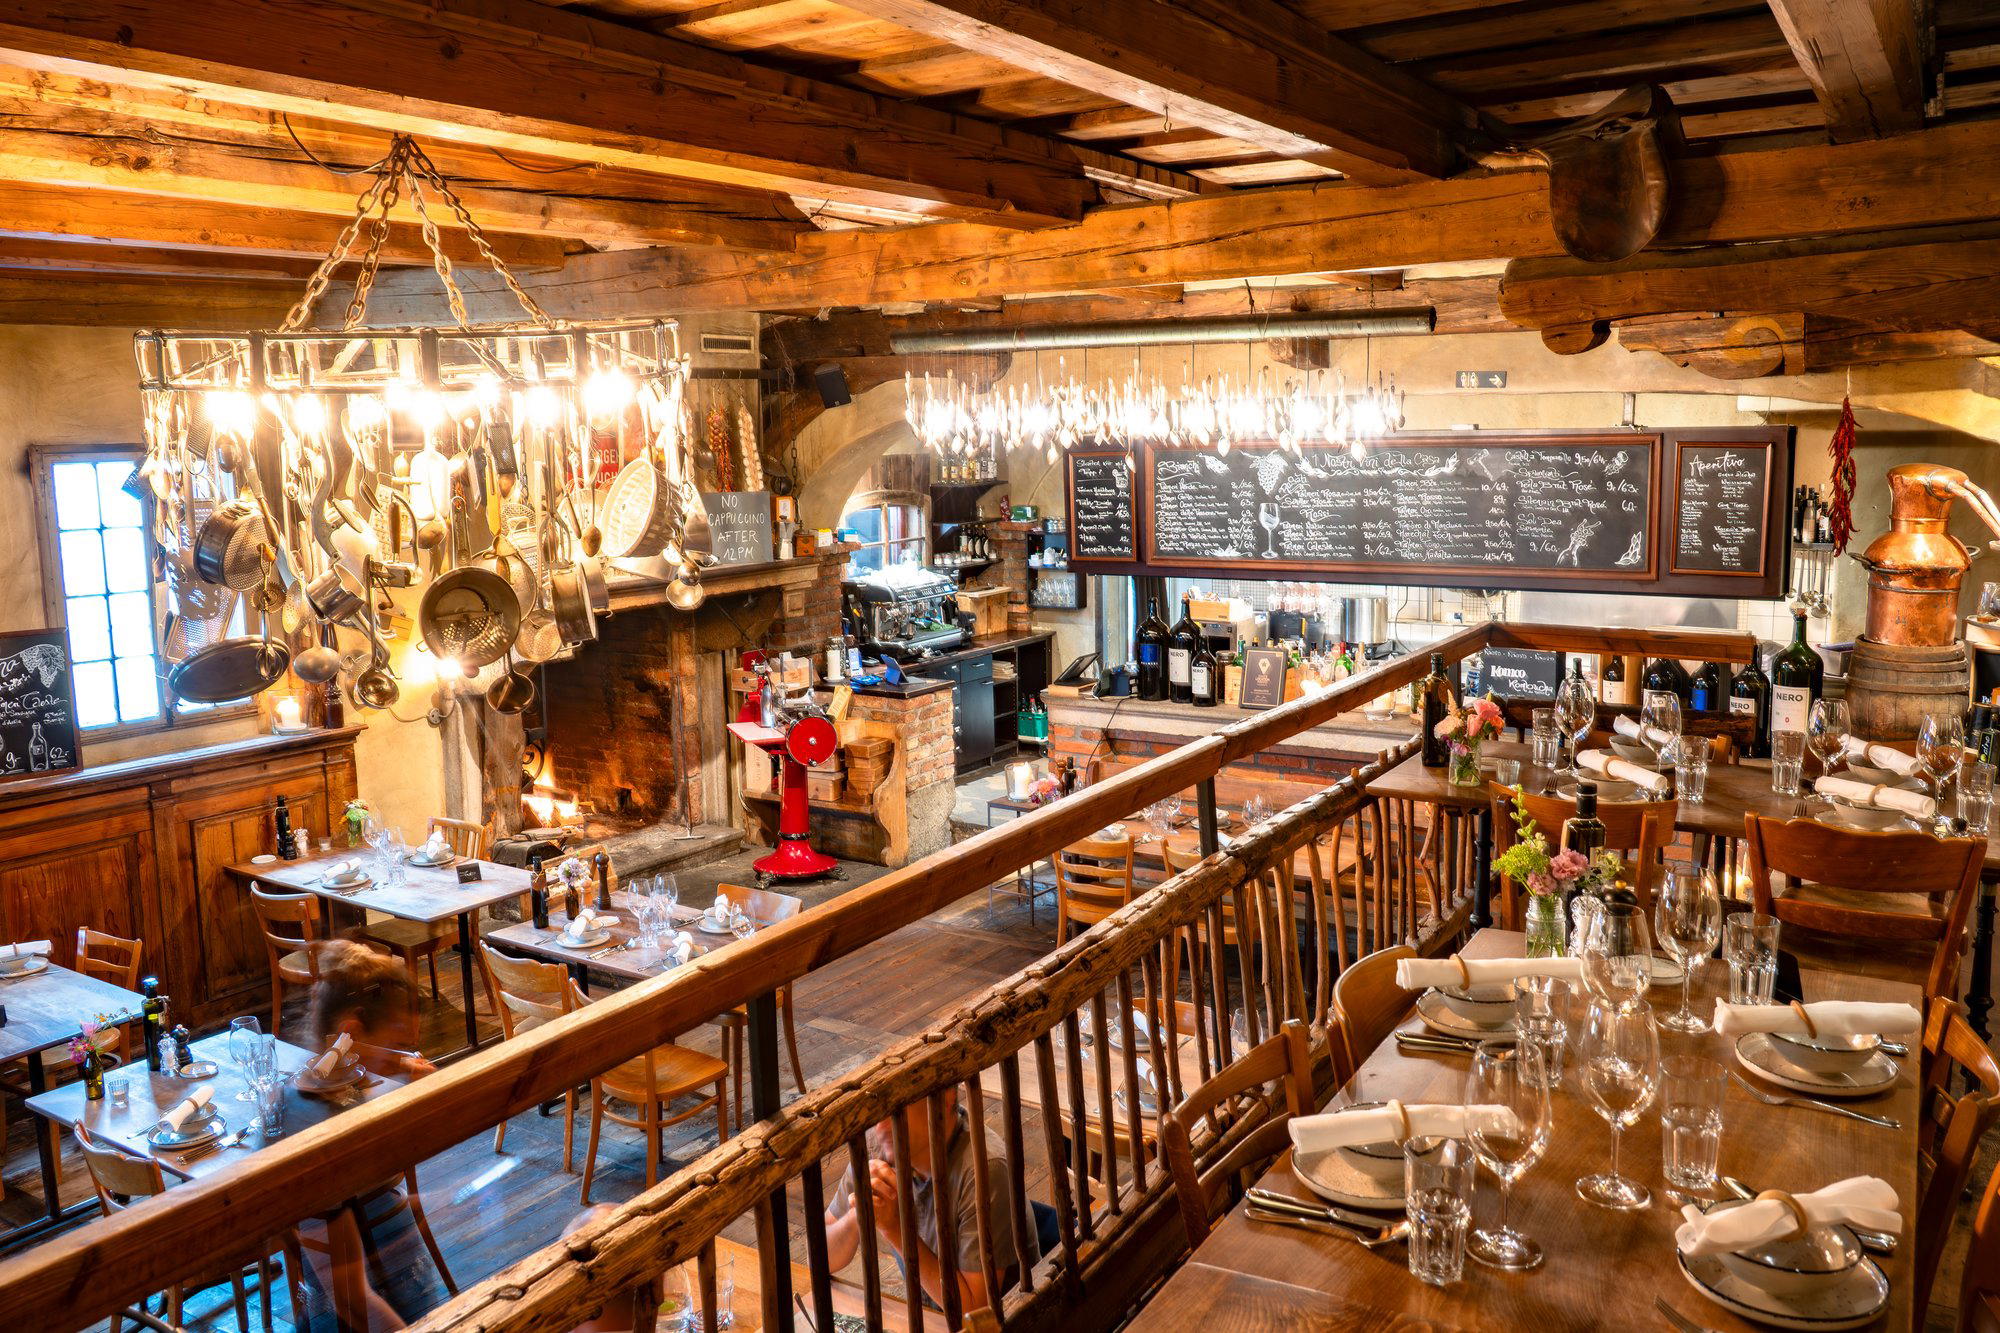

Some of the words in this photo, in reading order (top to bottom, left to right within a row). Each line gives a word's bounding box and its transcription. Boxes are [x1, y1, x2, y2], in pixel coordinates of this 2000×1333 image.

[1320, 453, 1355, 470] Nostri
[1383, 452, 1412, 469] della
[1413, 452, 1440, 467] Casa
[1689, 450, 1745, 477] Aperitivo
[1569, 480, 1597, 494] Rosé
[721, 494, 738, 509] NO
[708, 512, 765, 527] CAPPUCCINO
[717, 530, 759, 543] AFTER
[1490, 665, 1526, 679] Komco
[1776, 692, 1803, 702] NERO
[1731, 701, 1750, 710] NERO
